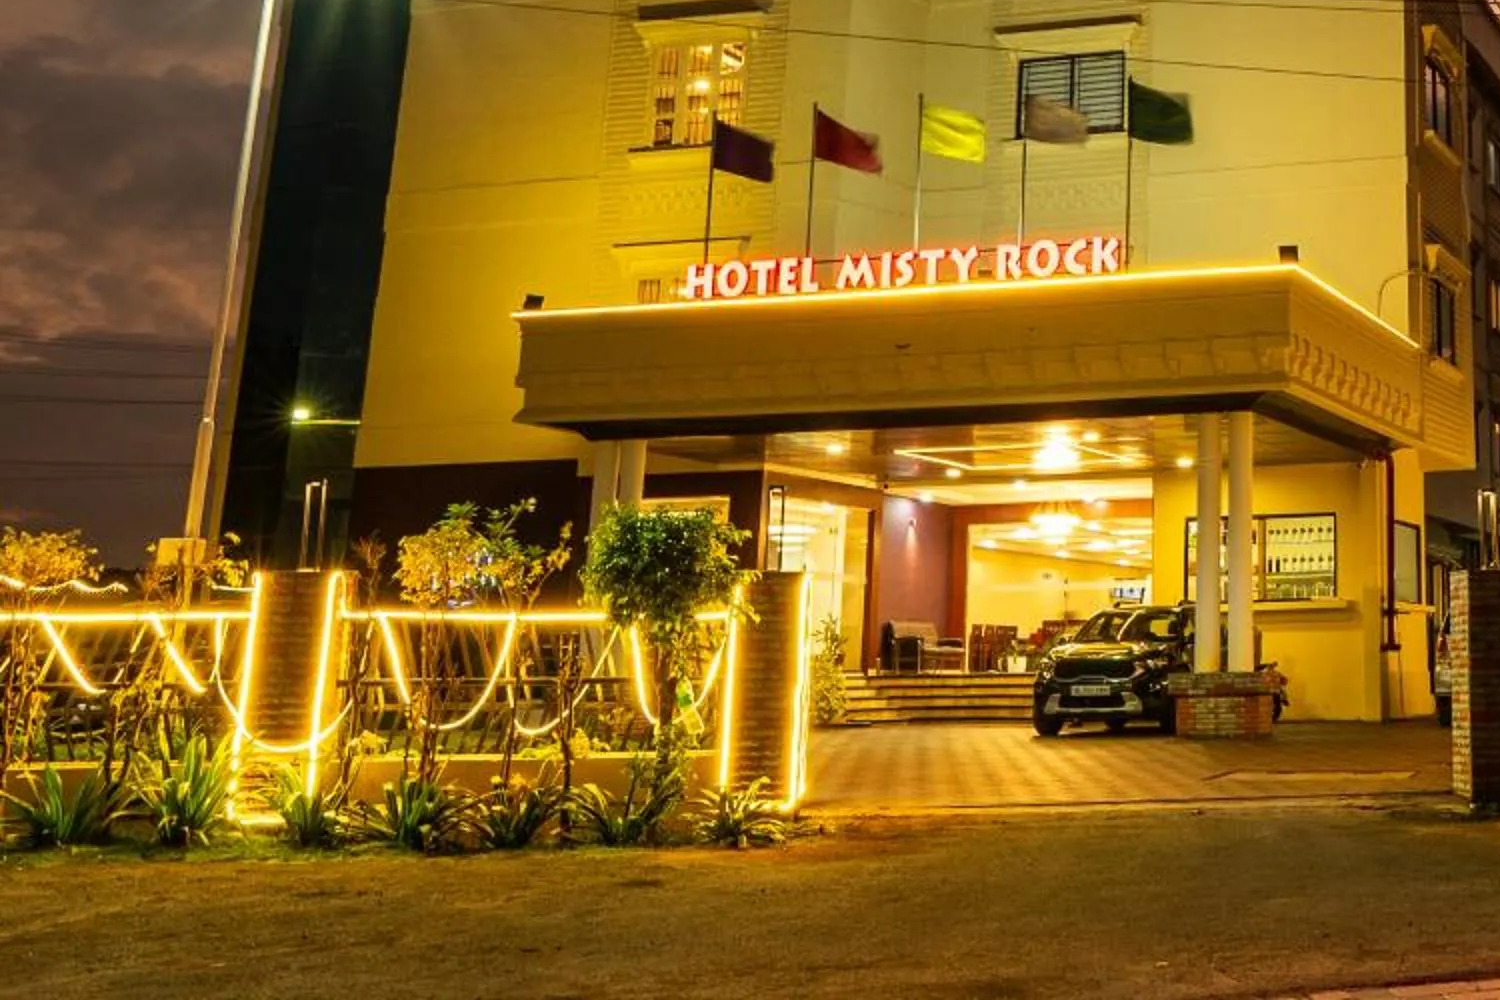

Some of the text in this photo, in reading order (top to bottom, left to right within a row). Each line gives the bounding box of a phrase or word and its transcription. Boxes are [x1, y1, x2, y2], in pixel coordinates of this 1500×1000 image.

[684, 236, 1121, 300] HOTEL MISTY ROCK
